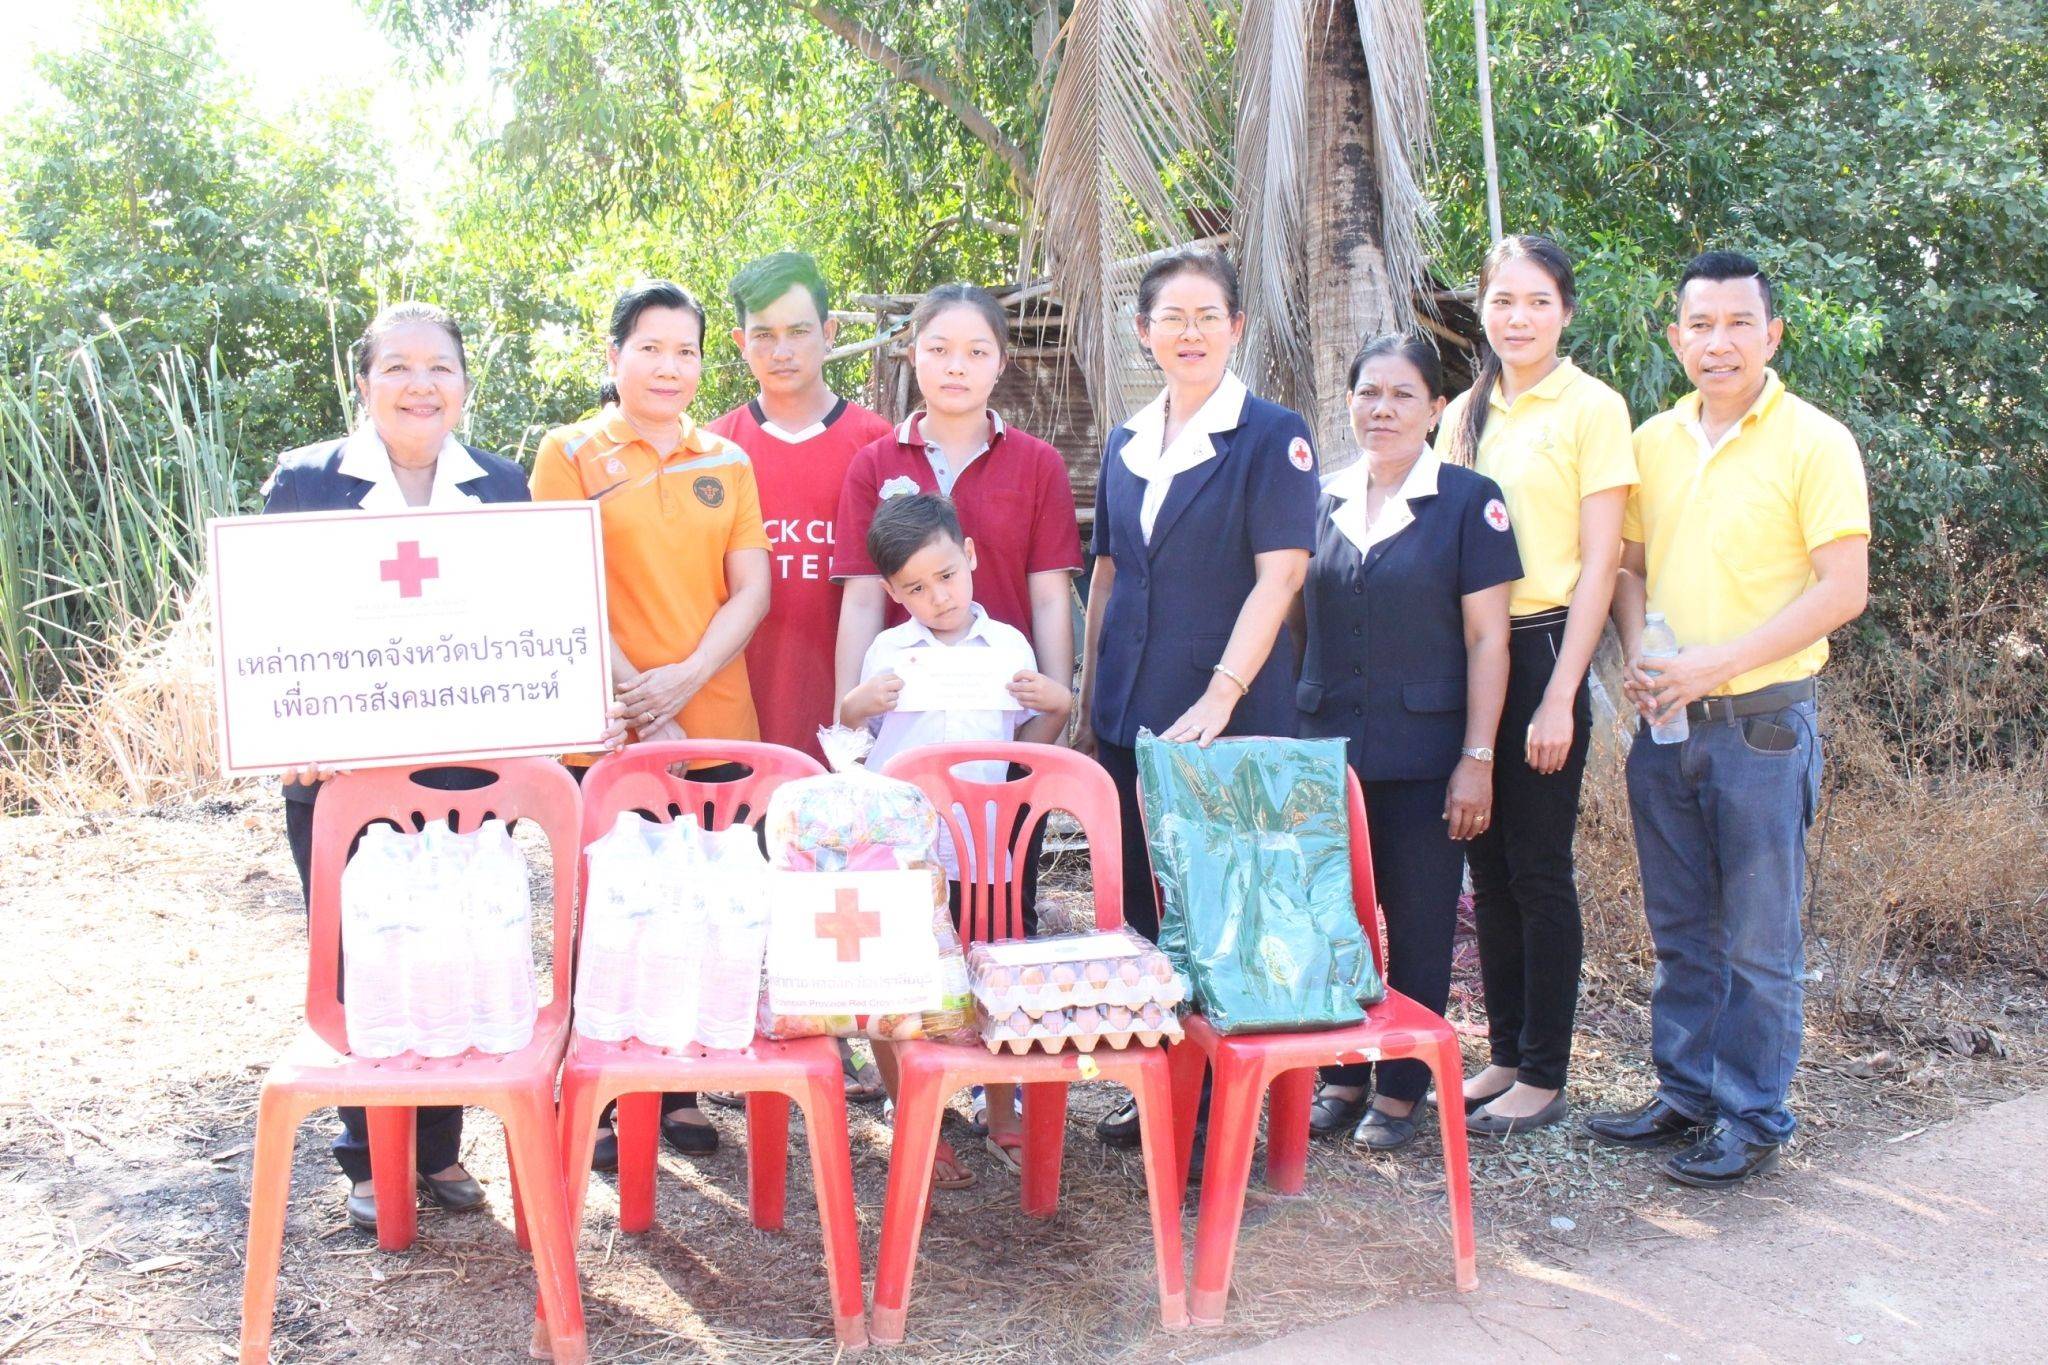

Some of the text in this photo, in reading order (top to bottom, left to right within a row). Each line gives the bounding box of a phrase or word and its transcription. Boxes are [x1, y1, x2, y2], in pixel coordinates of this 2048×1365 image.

[776, 554, 834, 579] TE
[238, 627, 587, 676] เหล่ากาชาดจังหวัดปราจีนบุรี
[273, 669, 559, 718] เพื่อการสังคมสงเคราะห์
[848, 999, 867, 1008] Red
